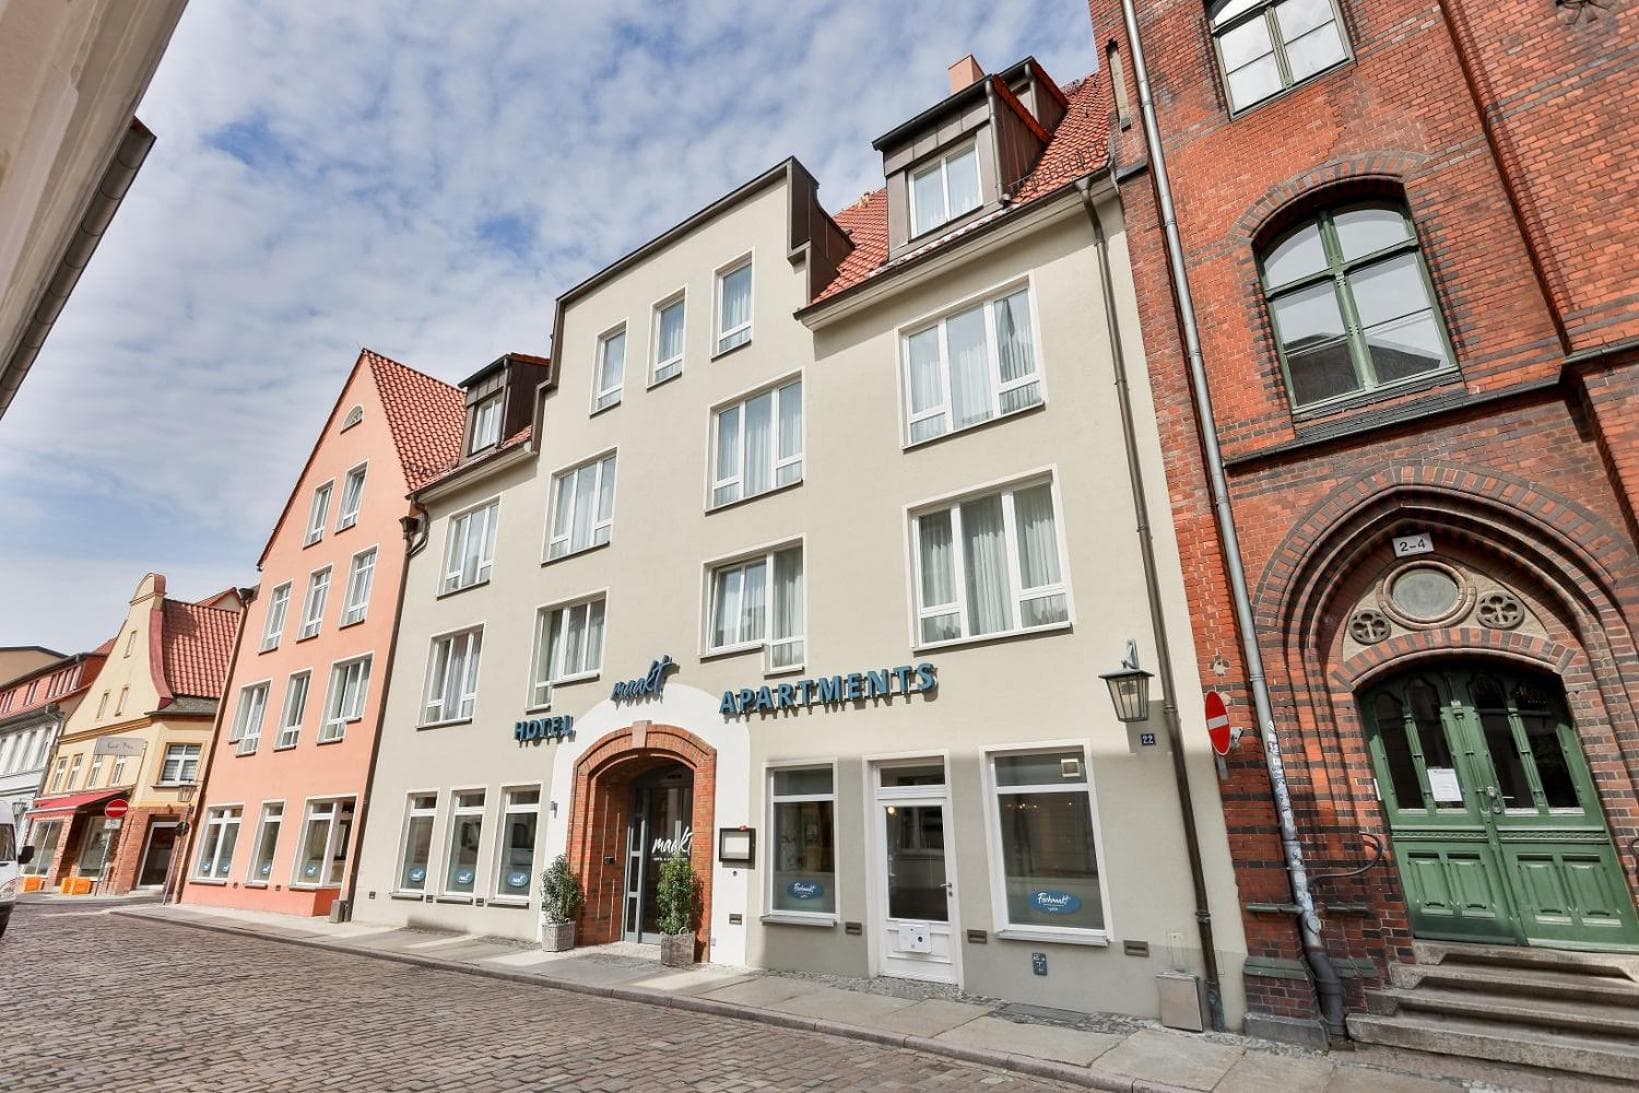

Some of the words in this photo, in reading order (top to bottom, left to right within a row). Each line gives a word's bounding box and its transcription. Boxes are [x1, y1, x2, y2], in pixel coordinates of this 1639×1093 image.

[1399, 538, 1426, 552] 2-4
[719, 663, 936, 715] APARTMENTS
[514, 714, 573, 742] HOTEL
[1142, 734, 1154, 745] 22
